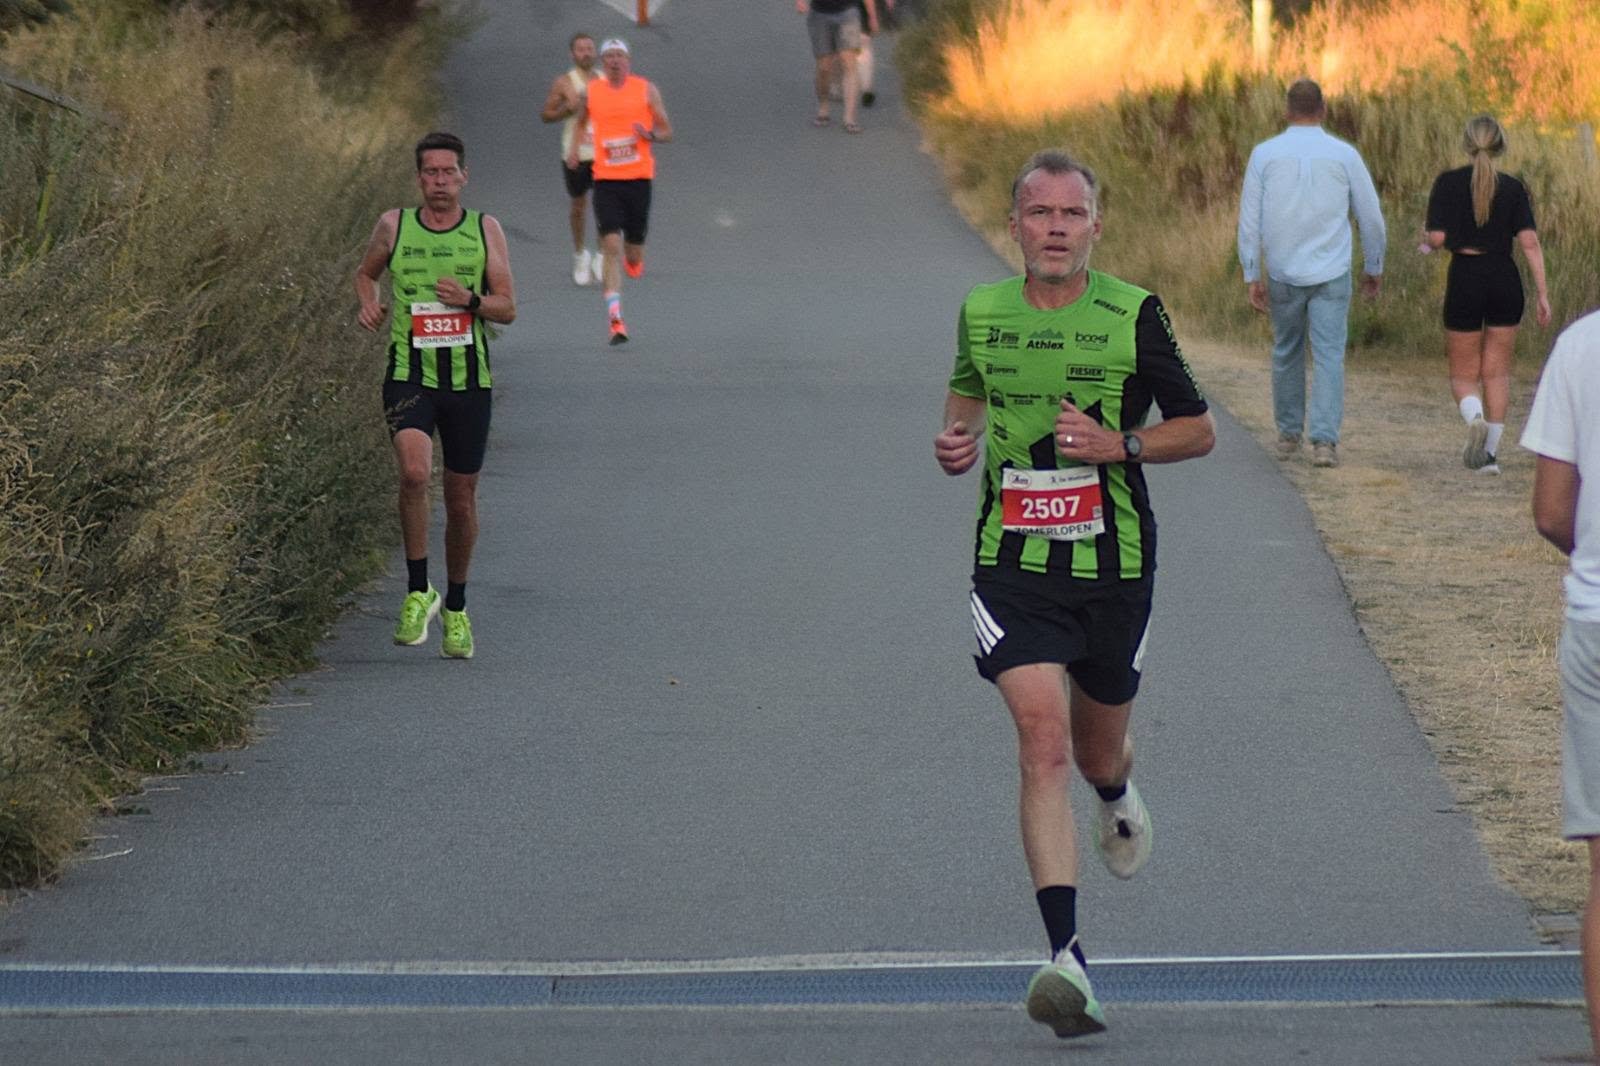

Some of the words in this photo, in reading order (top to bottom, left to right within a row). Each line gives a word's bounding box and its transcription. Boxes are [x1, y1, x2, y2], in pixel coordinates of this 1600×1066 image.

[424, 318, 460, 333] 3321
[420, 336, 466, 345] ZOMERLOPEN
[1021, 496, 1081, 520] 2507
